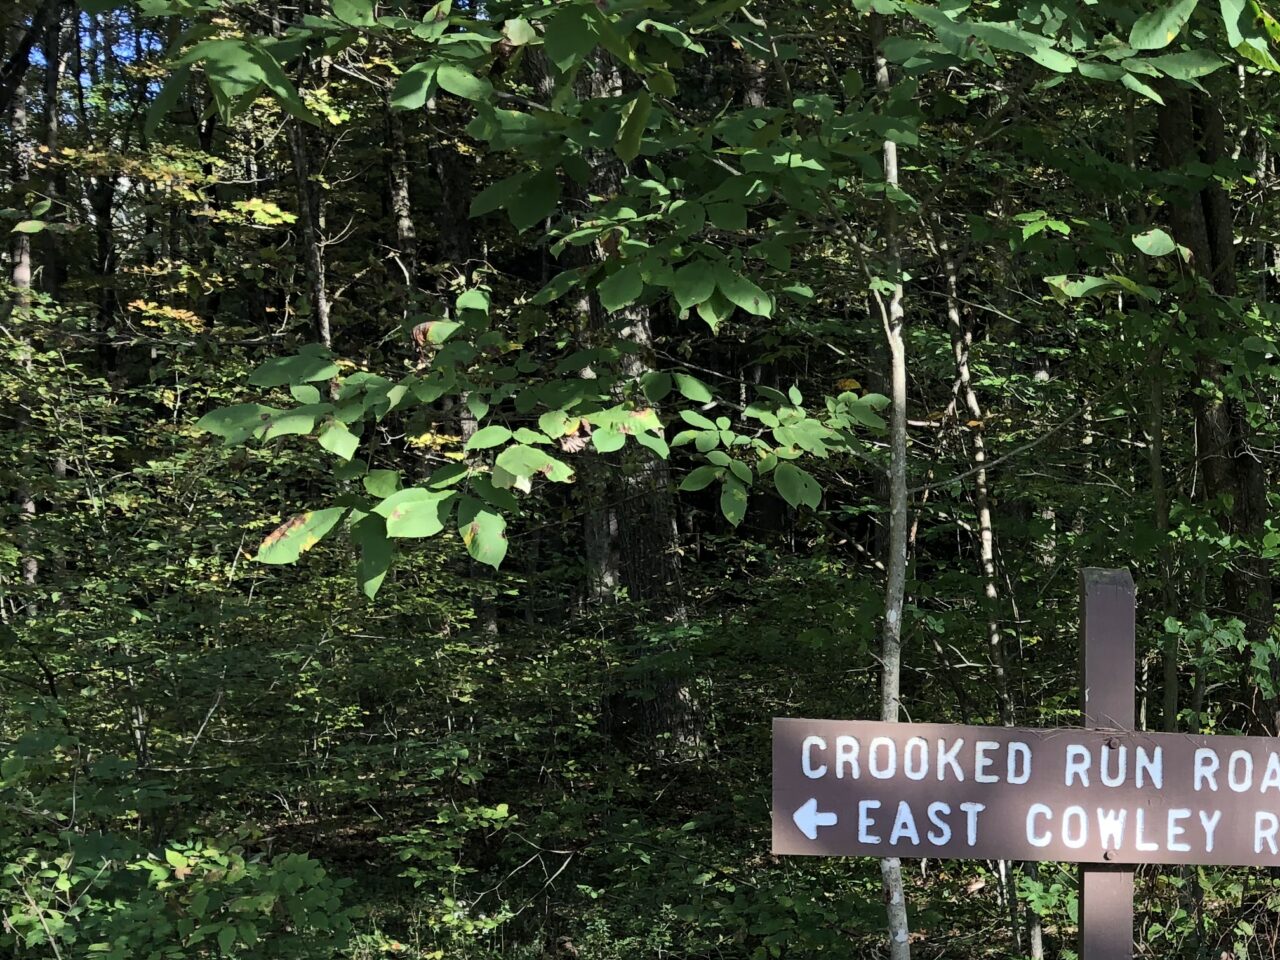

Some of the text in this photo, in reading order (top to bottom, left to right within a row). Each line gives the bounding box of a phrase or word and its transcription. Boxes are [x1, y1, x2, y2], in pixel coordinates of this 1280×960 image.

[801, 735, 1032, 785] CROOKED
[1065, 744, 1163, 789] RUN
[858, 800, 986, 847] EAST
[1025, 803, 1222, 852] COWLEY
